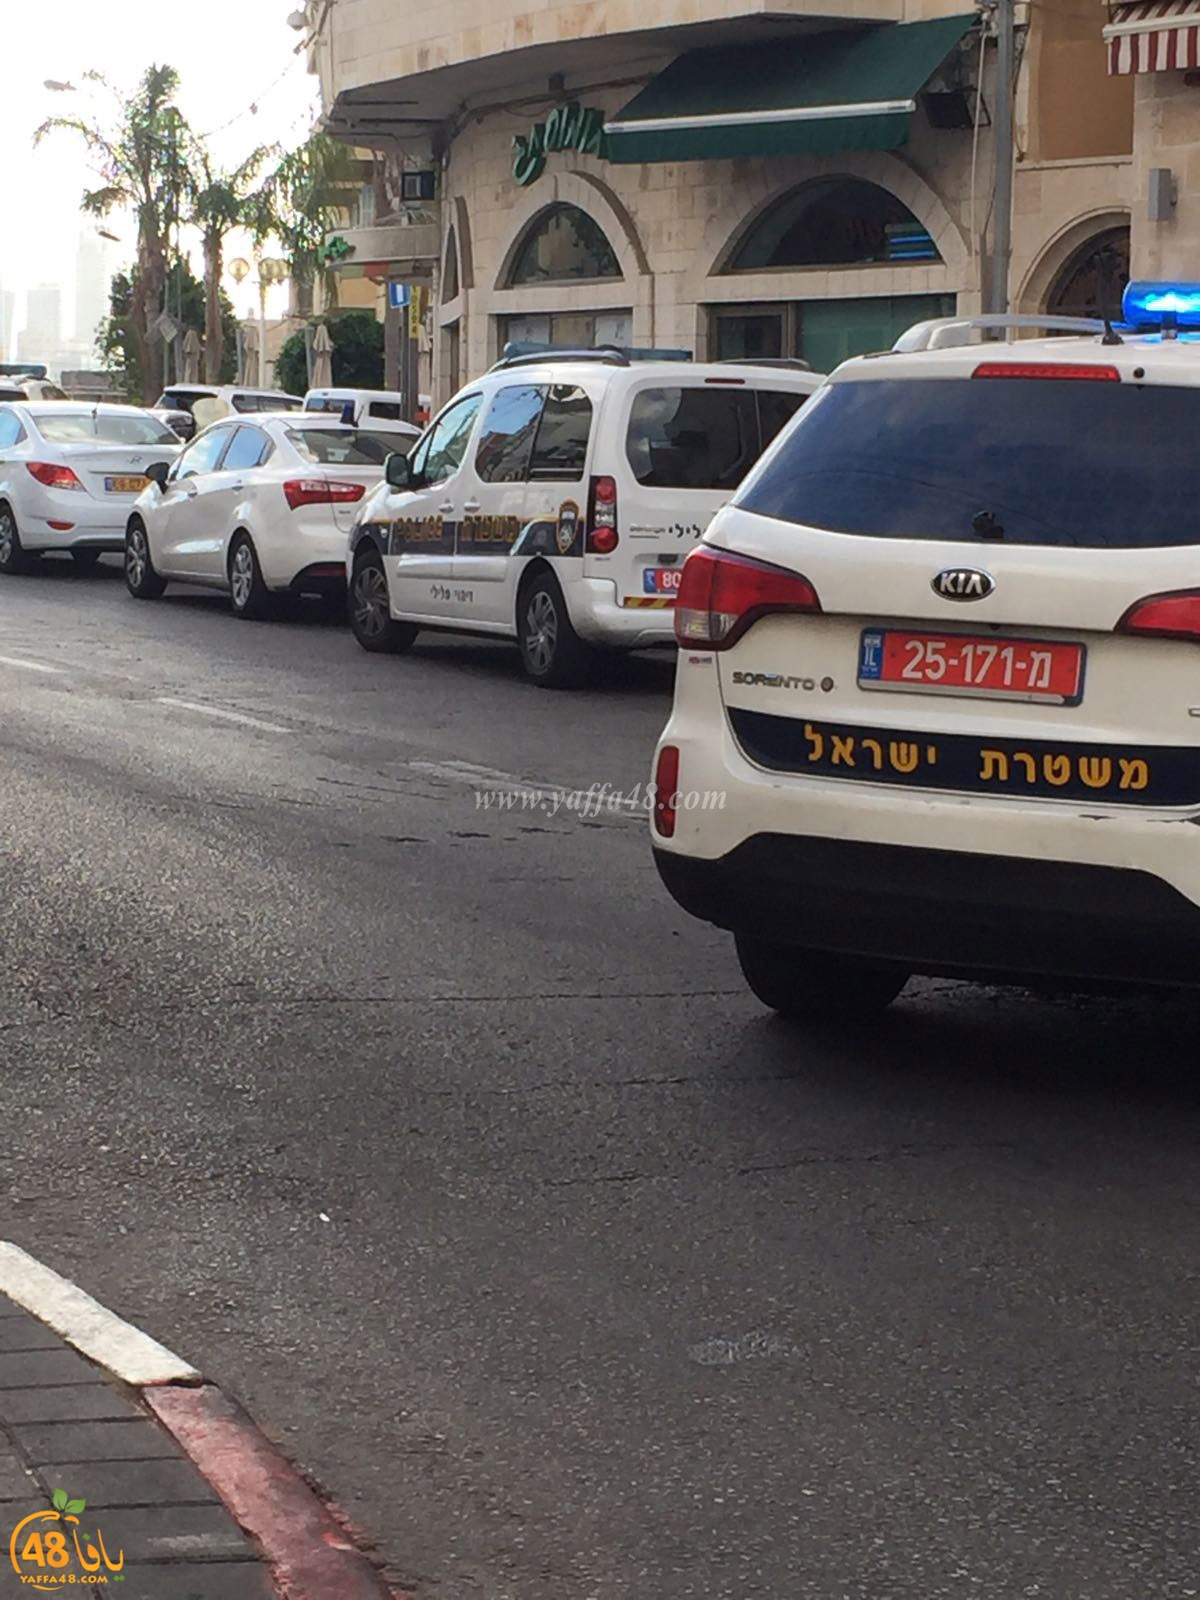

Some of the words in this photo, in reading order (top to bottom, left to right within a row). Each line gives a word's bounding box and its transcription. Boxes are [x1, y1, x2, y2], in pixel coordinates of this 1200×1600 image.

[668, 523, 708, 539] לילי
[940, 572, 984, 594] KIA
[732, 671, 815, 691] SORENTO
[803, 723, 937, 773] ישראל
[979, 749, 1149, 790] משטרת
